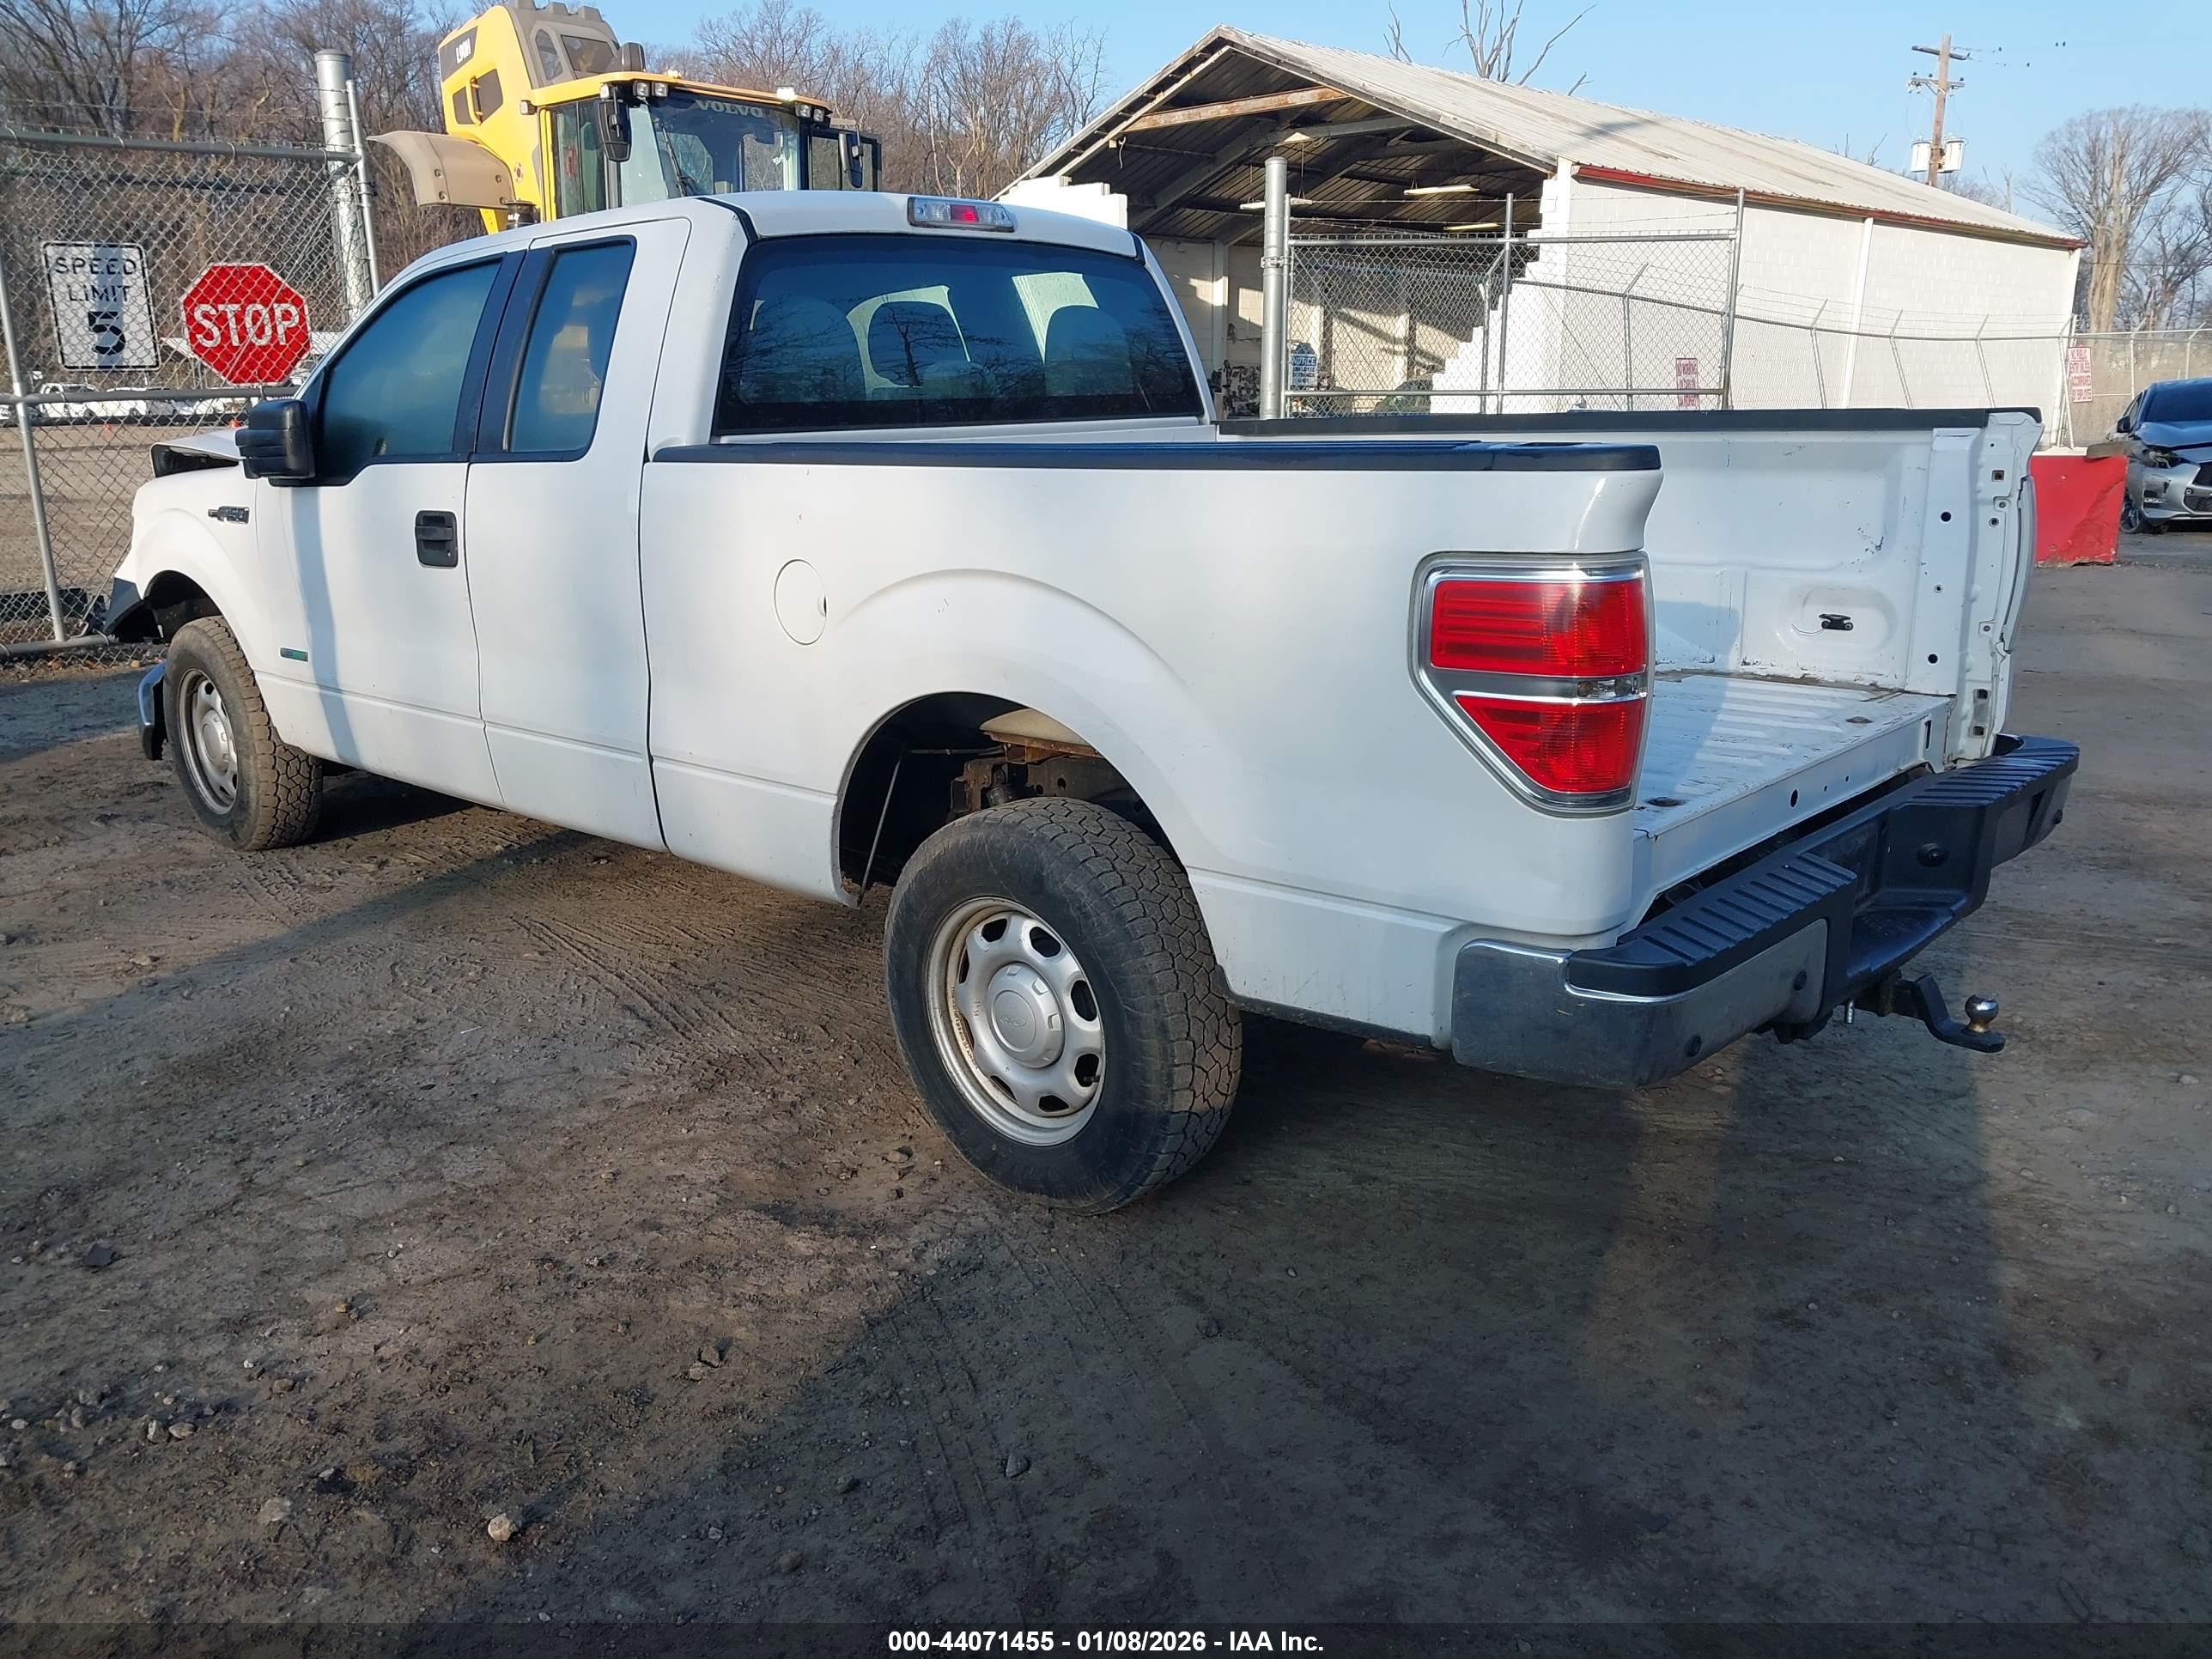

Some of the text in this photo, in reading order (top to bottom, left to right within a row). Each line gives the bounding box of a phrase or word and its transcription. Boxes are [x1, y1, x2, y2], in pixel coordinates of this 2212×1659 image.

[695, 100, 763, 118] VOLVO
[54, 257, 137, 275] SPEED
[66, 284, 131, 302] LIMIT
[88, 311, 126, 356] 5
[192, 302, 301, 349] STOP
[1291, 357, 1316, 366] NOTICE
